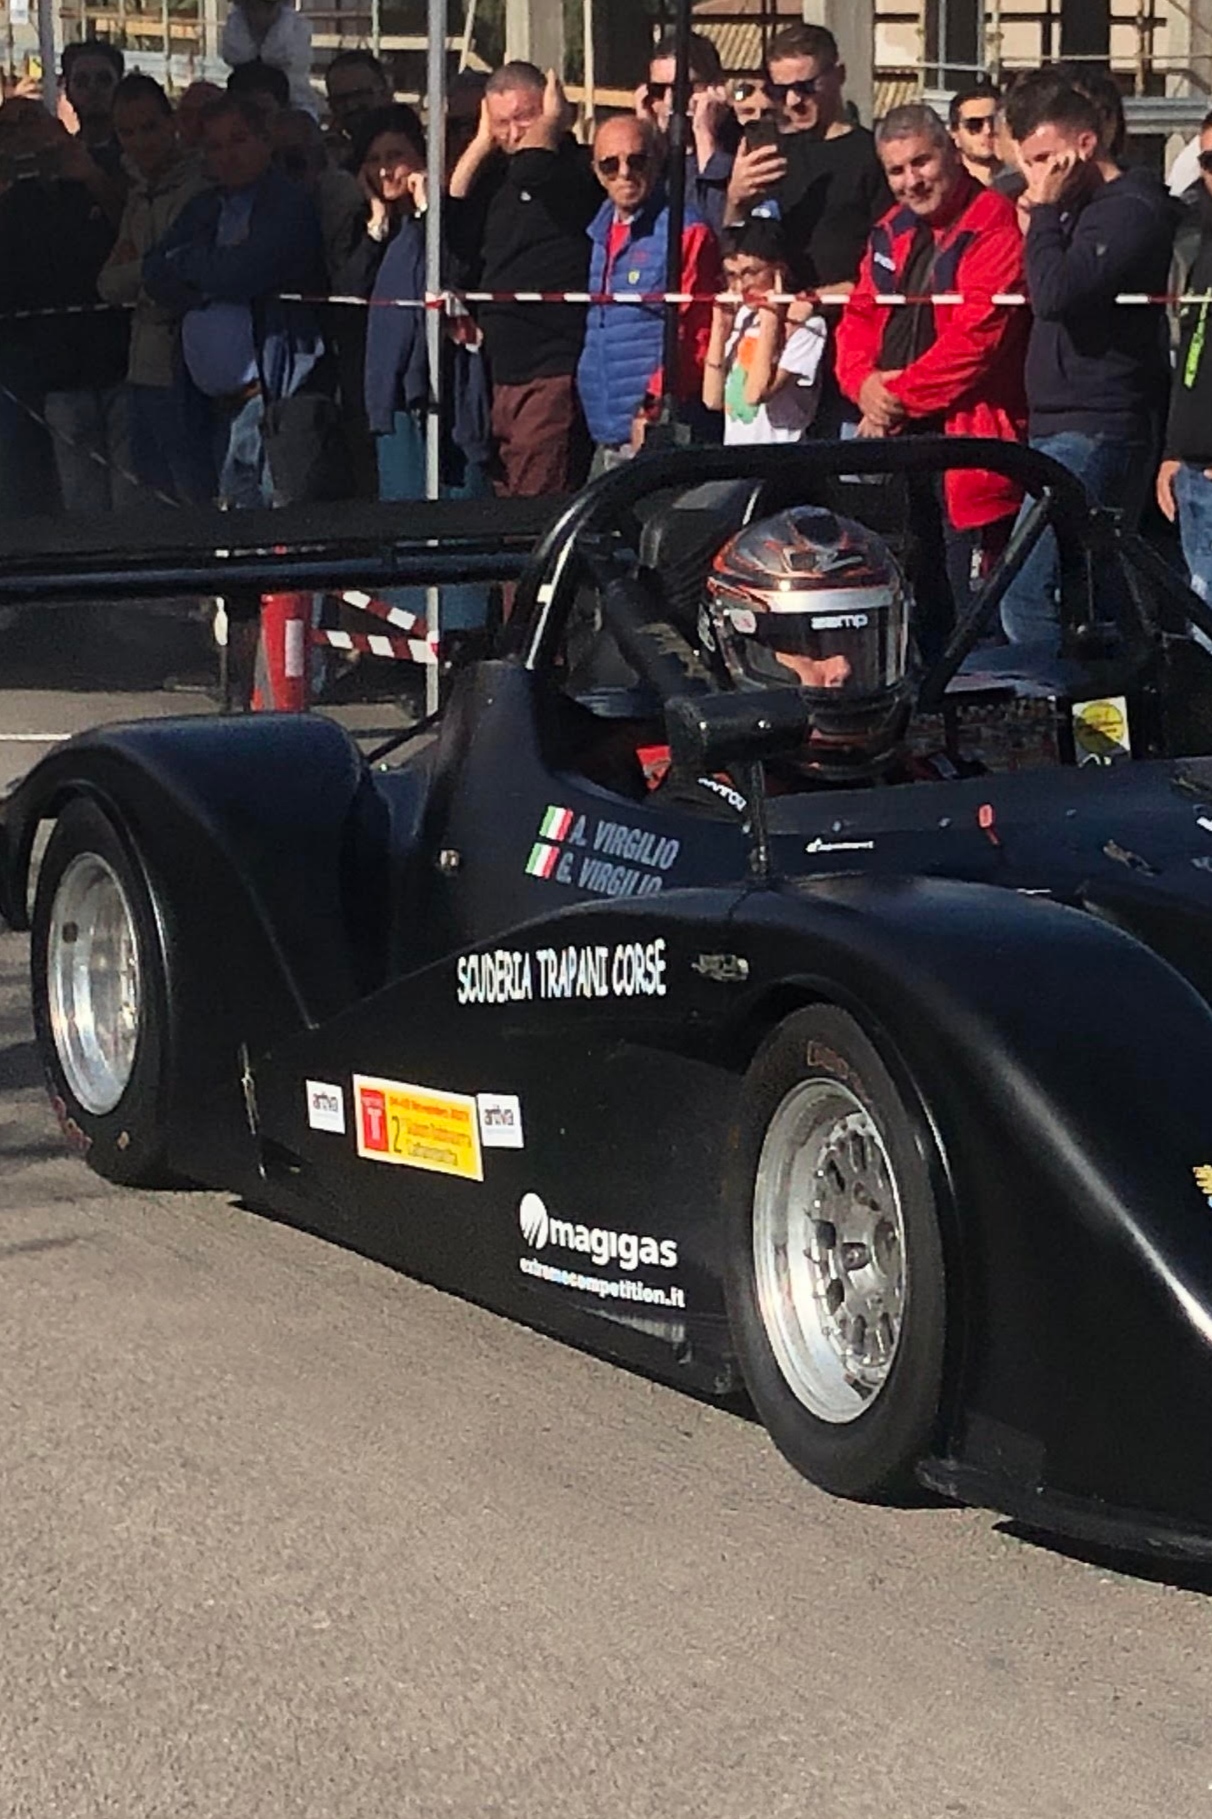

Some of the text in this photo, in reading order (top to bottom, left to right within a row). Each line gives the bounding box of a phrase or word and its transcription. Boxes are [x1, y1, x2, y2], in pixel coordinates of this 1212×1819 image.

[593, 819, 680, 870] VIRGILIO
[457, 938, 667, 1004] SCUDERIA TRAPANI CORSE
[549, 1217, 678, 1271] magigas
